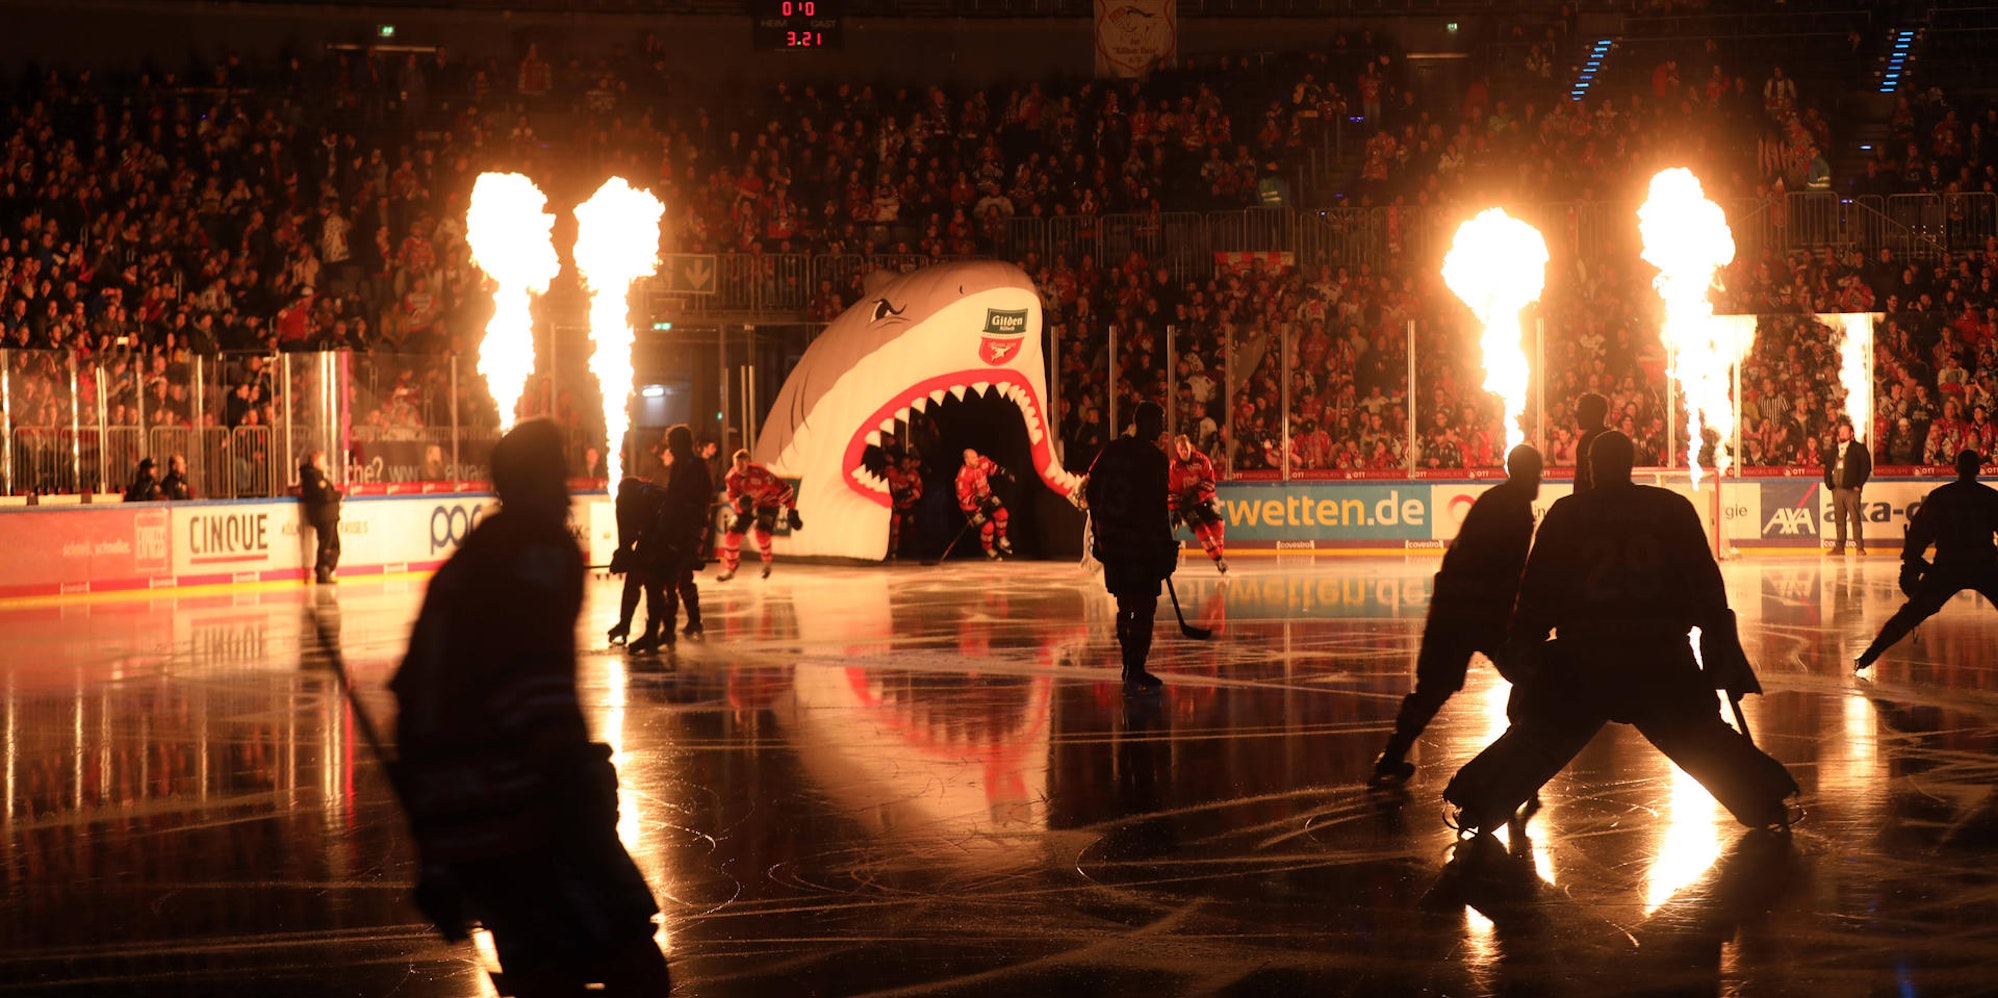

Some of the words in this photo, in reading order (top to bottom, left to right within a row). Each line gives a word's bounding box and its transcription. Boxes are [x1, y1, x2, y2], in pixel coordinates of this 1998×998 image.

[992, 315, 1023, 327] Gilden
[1353, 471, 1366, 479] OTT
[1792, 467, 1805, 475] OTT
[1921, 467, 1934, 475] OTT
[1725, 504, 1748, 520] gie
[1762, 507, 1816, 534] AXA
[190, 514, 268, 553] CINQUE
